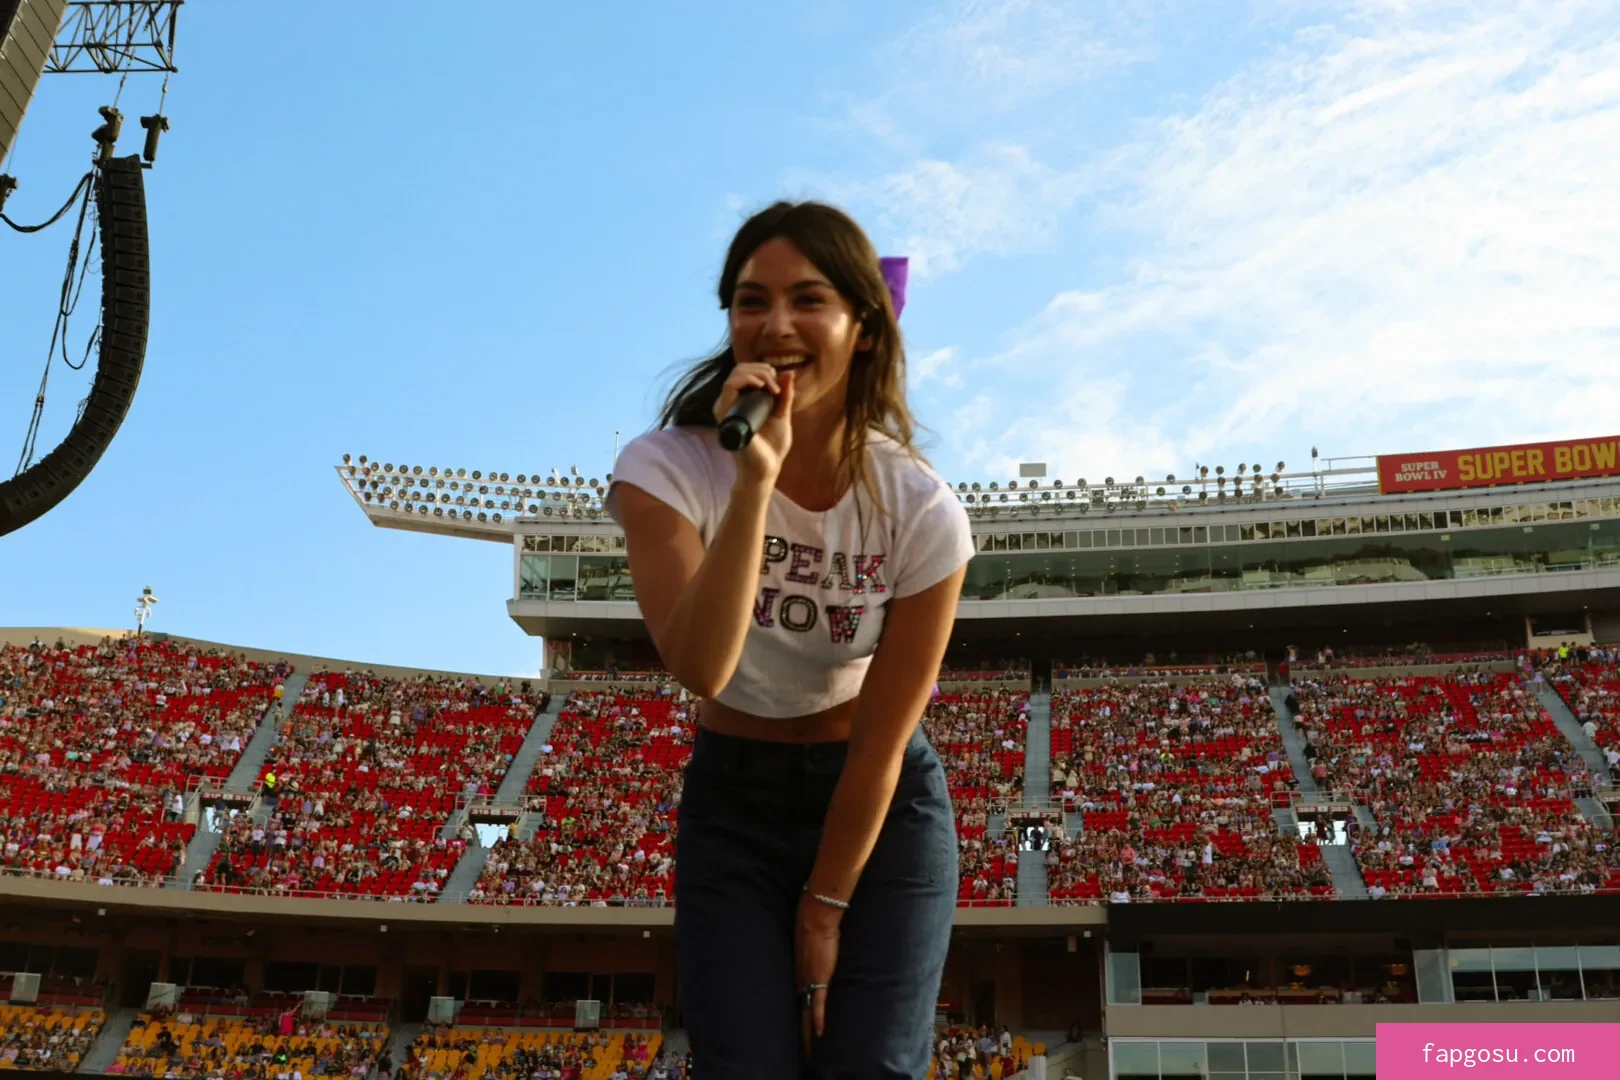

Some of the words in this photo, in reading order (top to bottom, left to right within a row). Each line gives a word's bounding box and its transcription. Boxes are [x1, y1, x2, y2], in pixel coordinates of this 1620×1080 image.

[1401, 461, 1439, 472] SUPER
[1458, 450, 1546, 481] SUPER
[1554, 442, 1620, 473] BOW
[1395, 471, 1431, 482] BOWL
[1433, 469, 1447, 480] IV
[760, 535, 886, 594] PEAK
